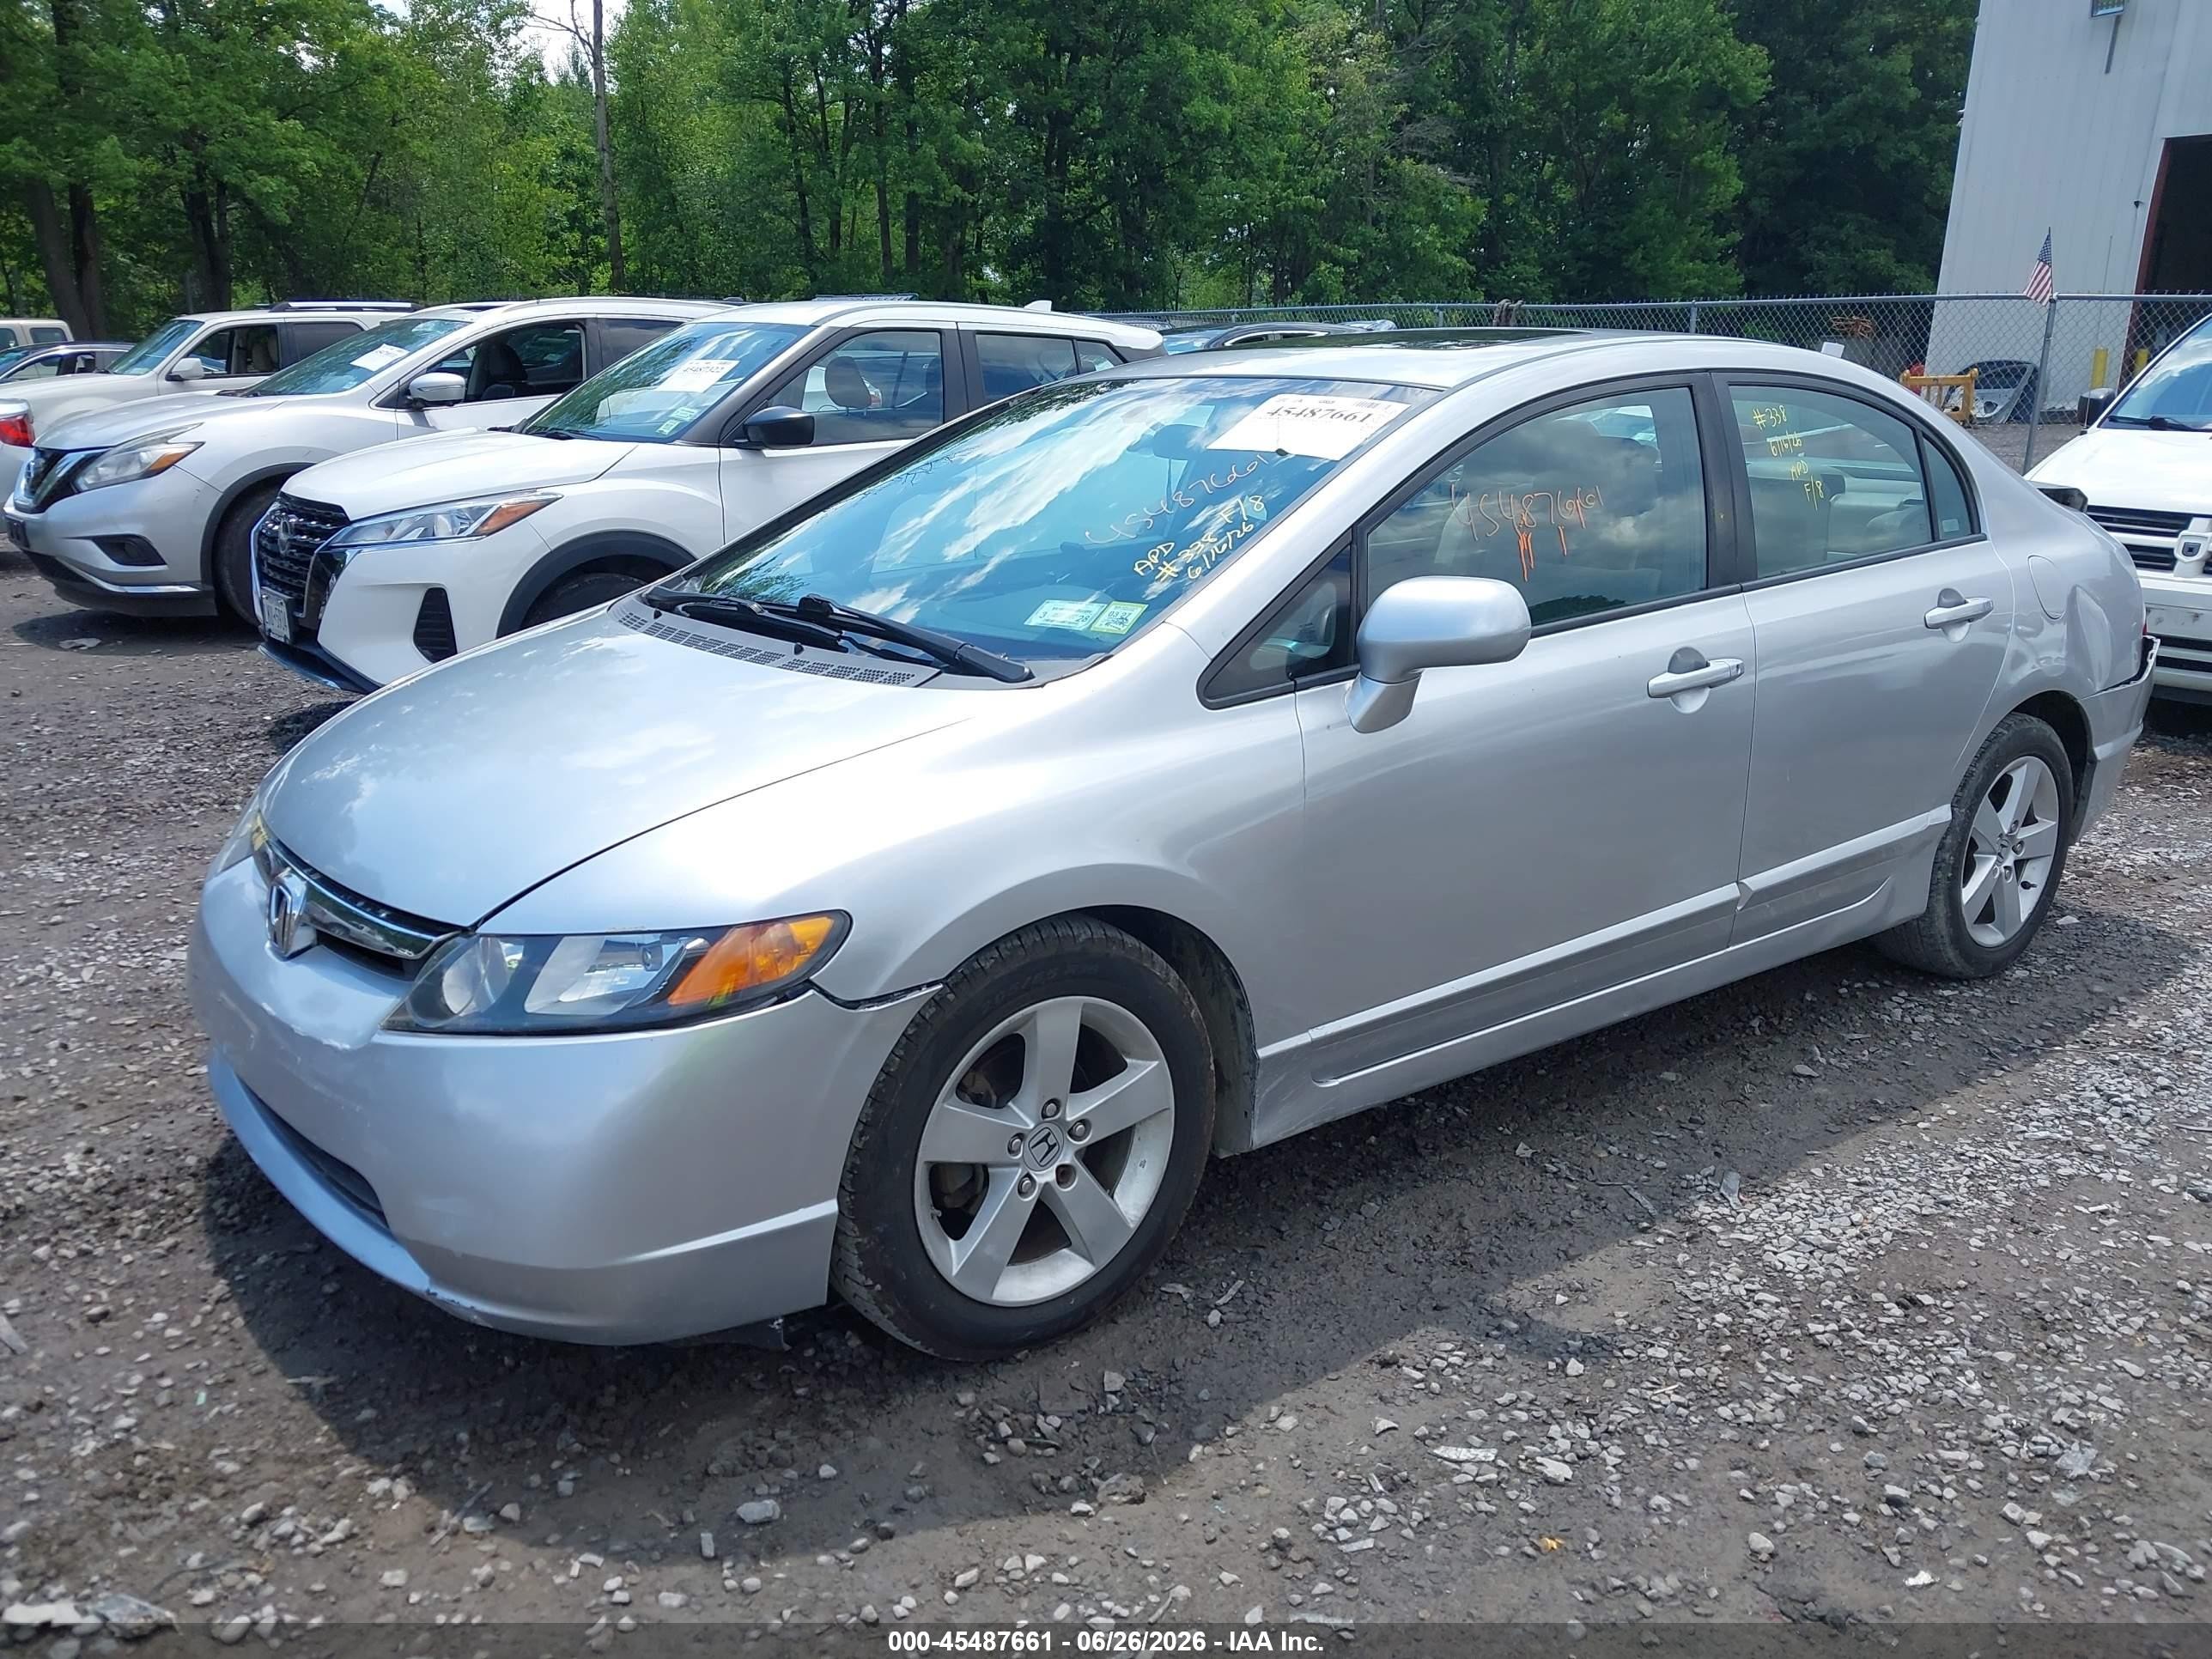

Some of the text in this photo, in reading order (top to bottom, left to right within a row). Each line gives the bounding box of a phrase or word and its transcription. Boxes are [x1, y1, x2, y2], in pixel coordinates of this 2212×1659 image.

[1267, 405, 1373, 423] 45487661
[1753, 404, 1787, 431] #338
[1449, 483, 1604, 542] 45487661
[1133, 541, 1176, 577] APD
